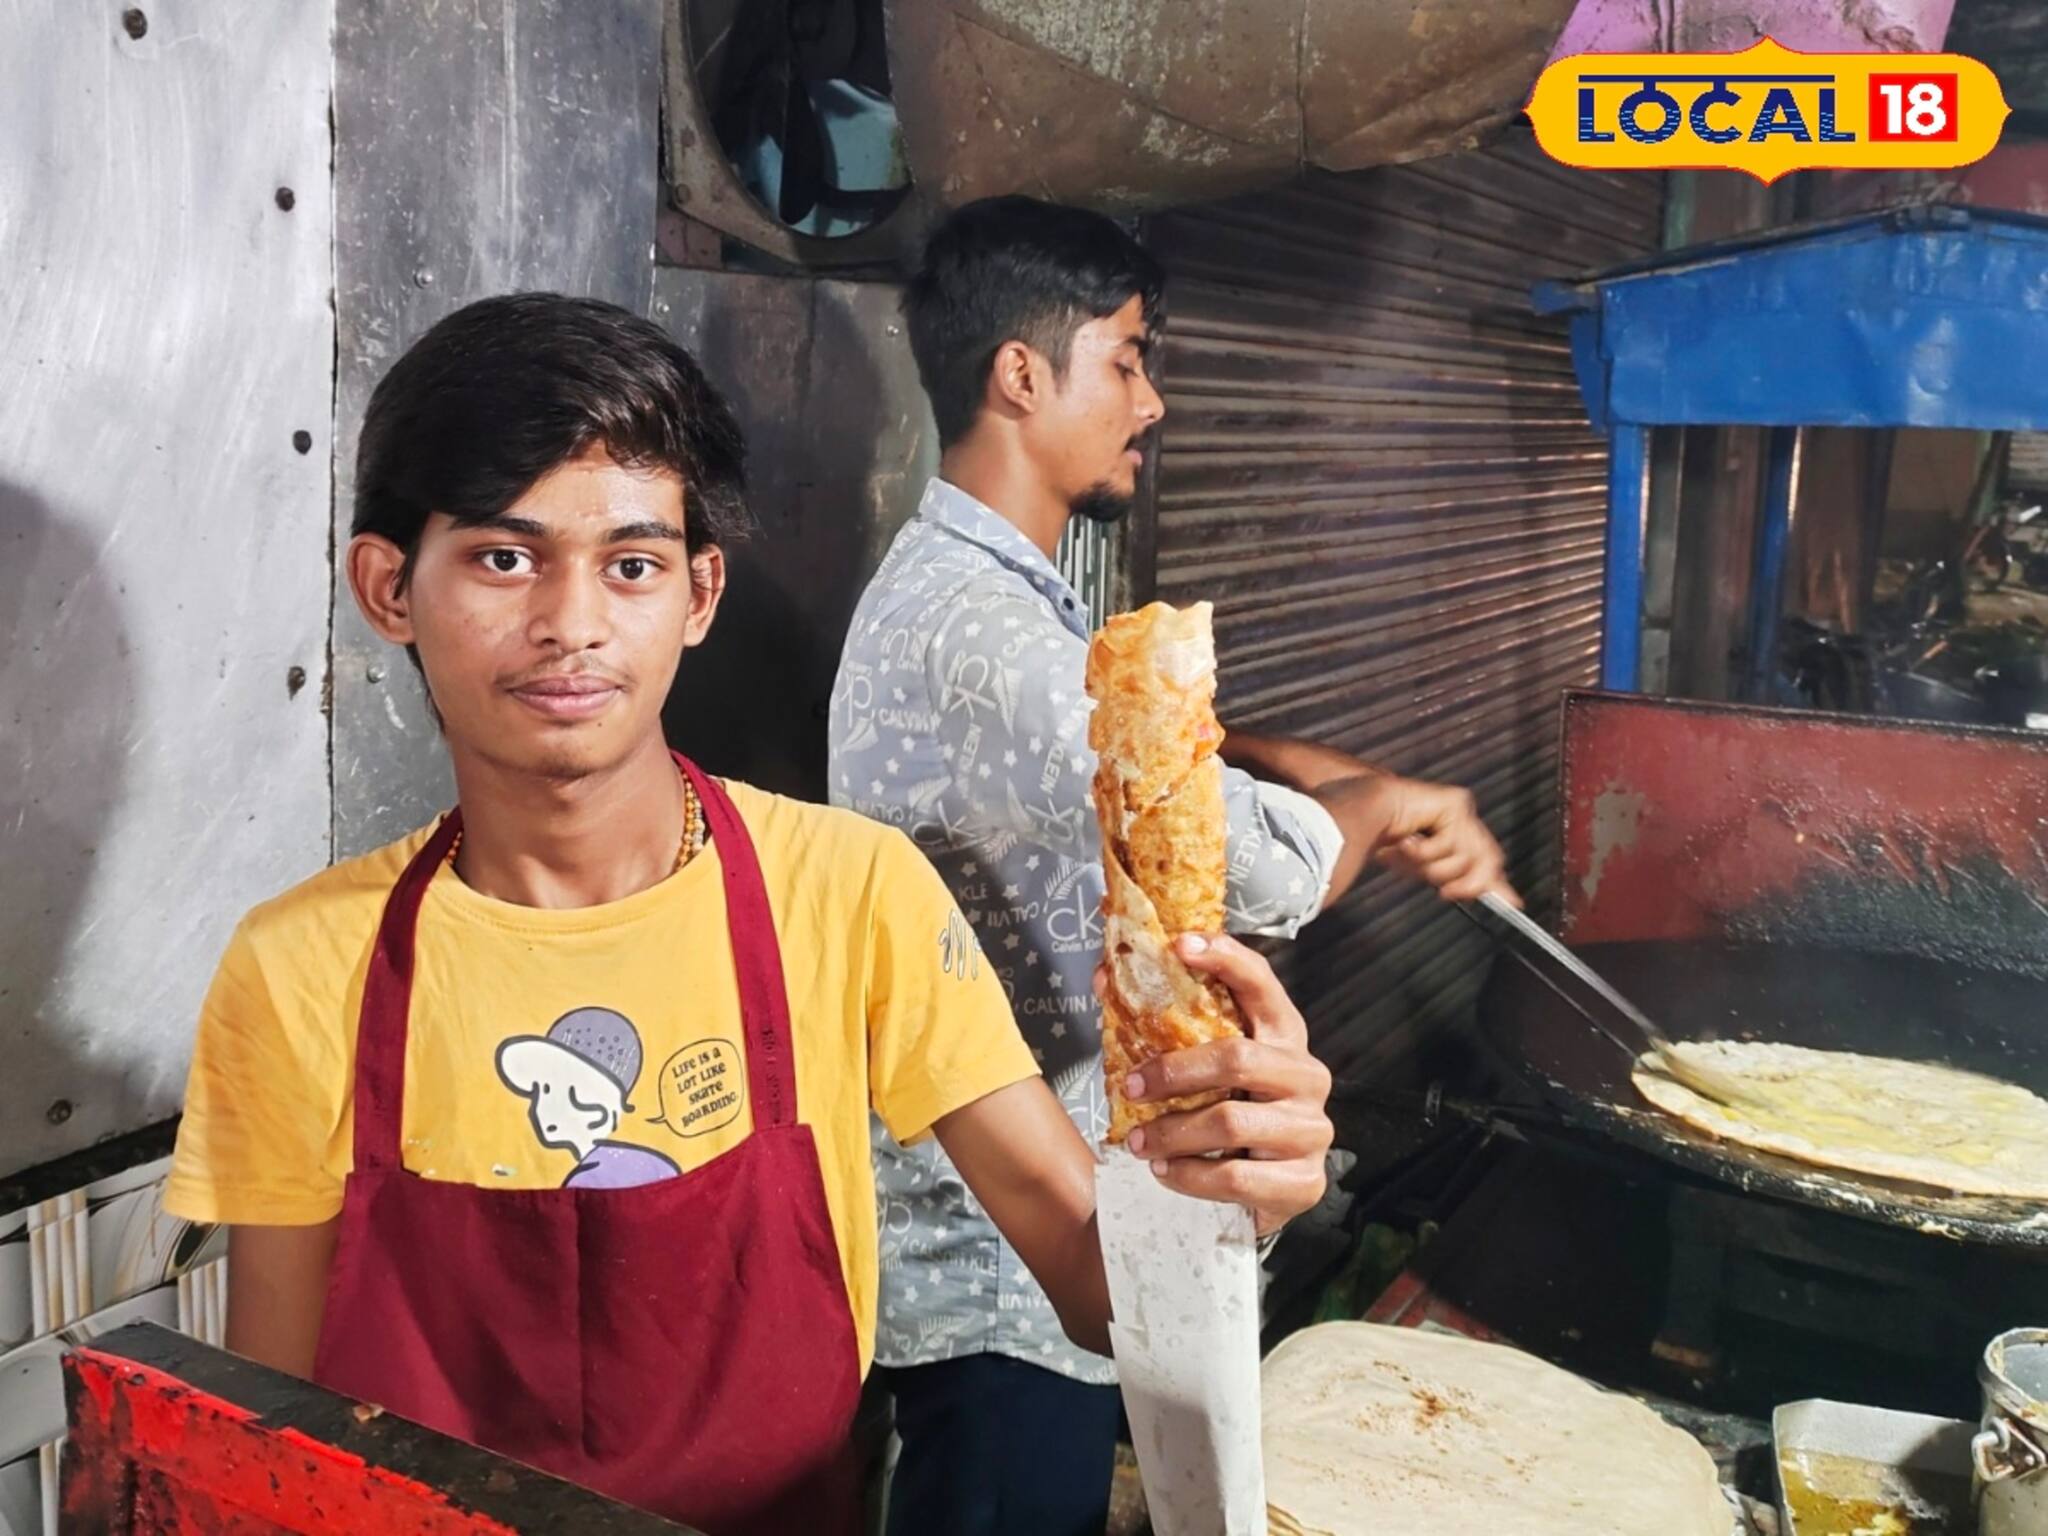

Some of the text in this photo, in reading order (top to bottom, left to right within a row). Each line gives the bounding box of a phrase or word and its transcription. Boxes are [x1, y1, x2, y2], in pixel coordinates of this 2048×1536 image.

[1228, 827, 1264, 886] KLEIN
[1047, 884, 1104, 941] ck
[1023, 995, 1088, 1015] CALVIN
[677, 1074, 698, 1095] LOT
